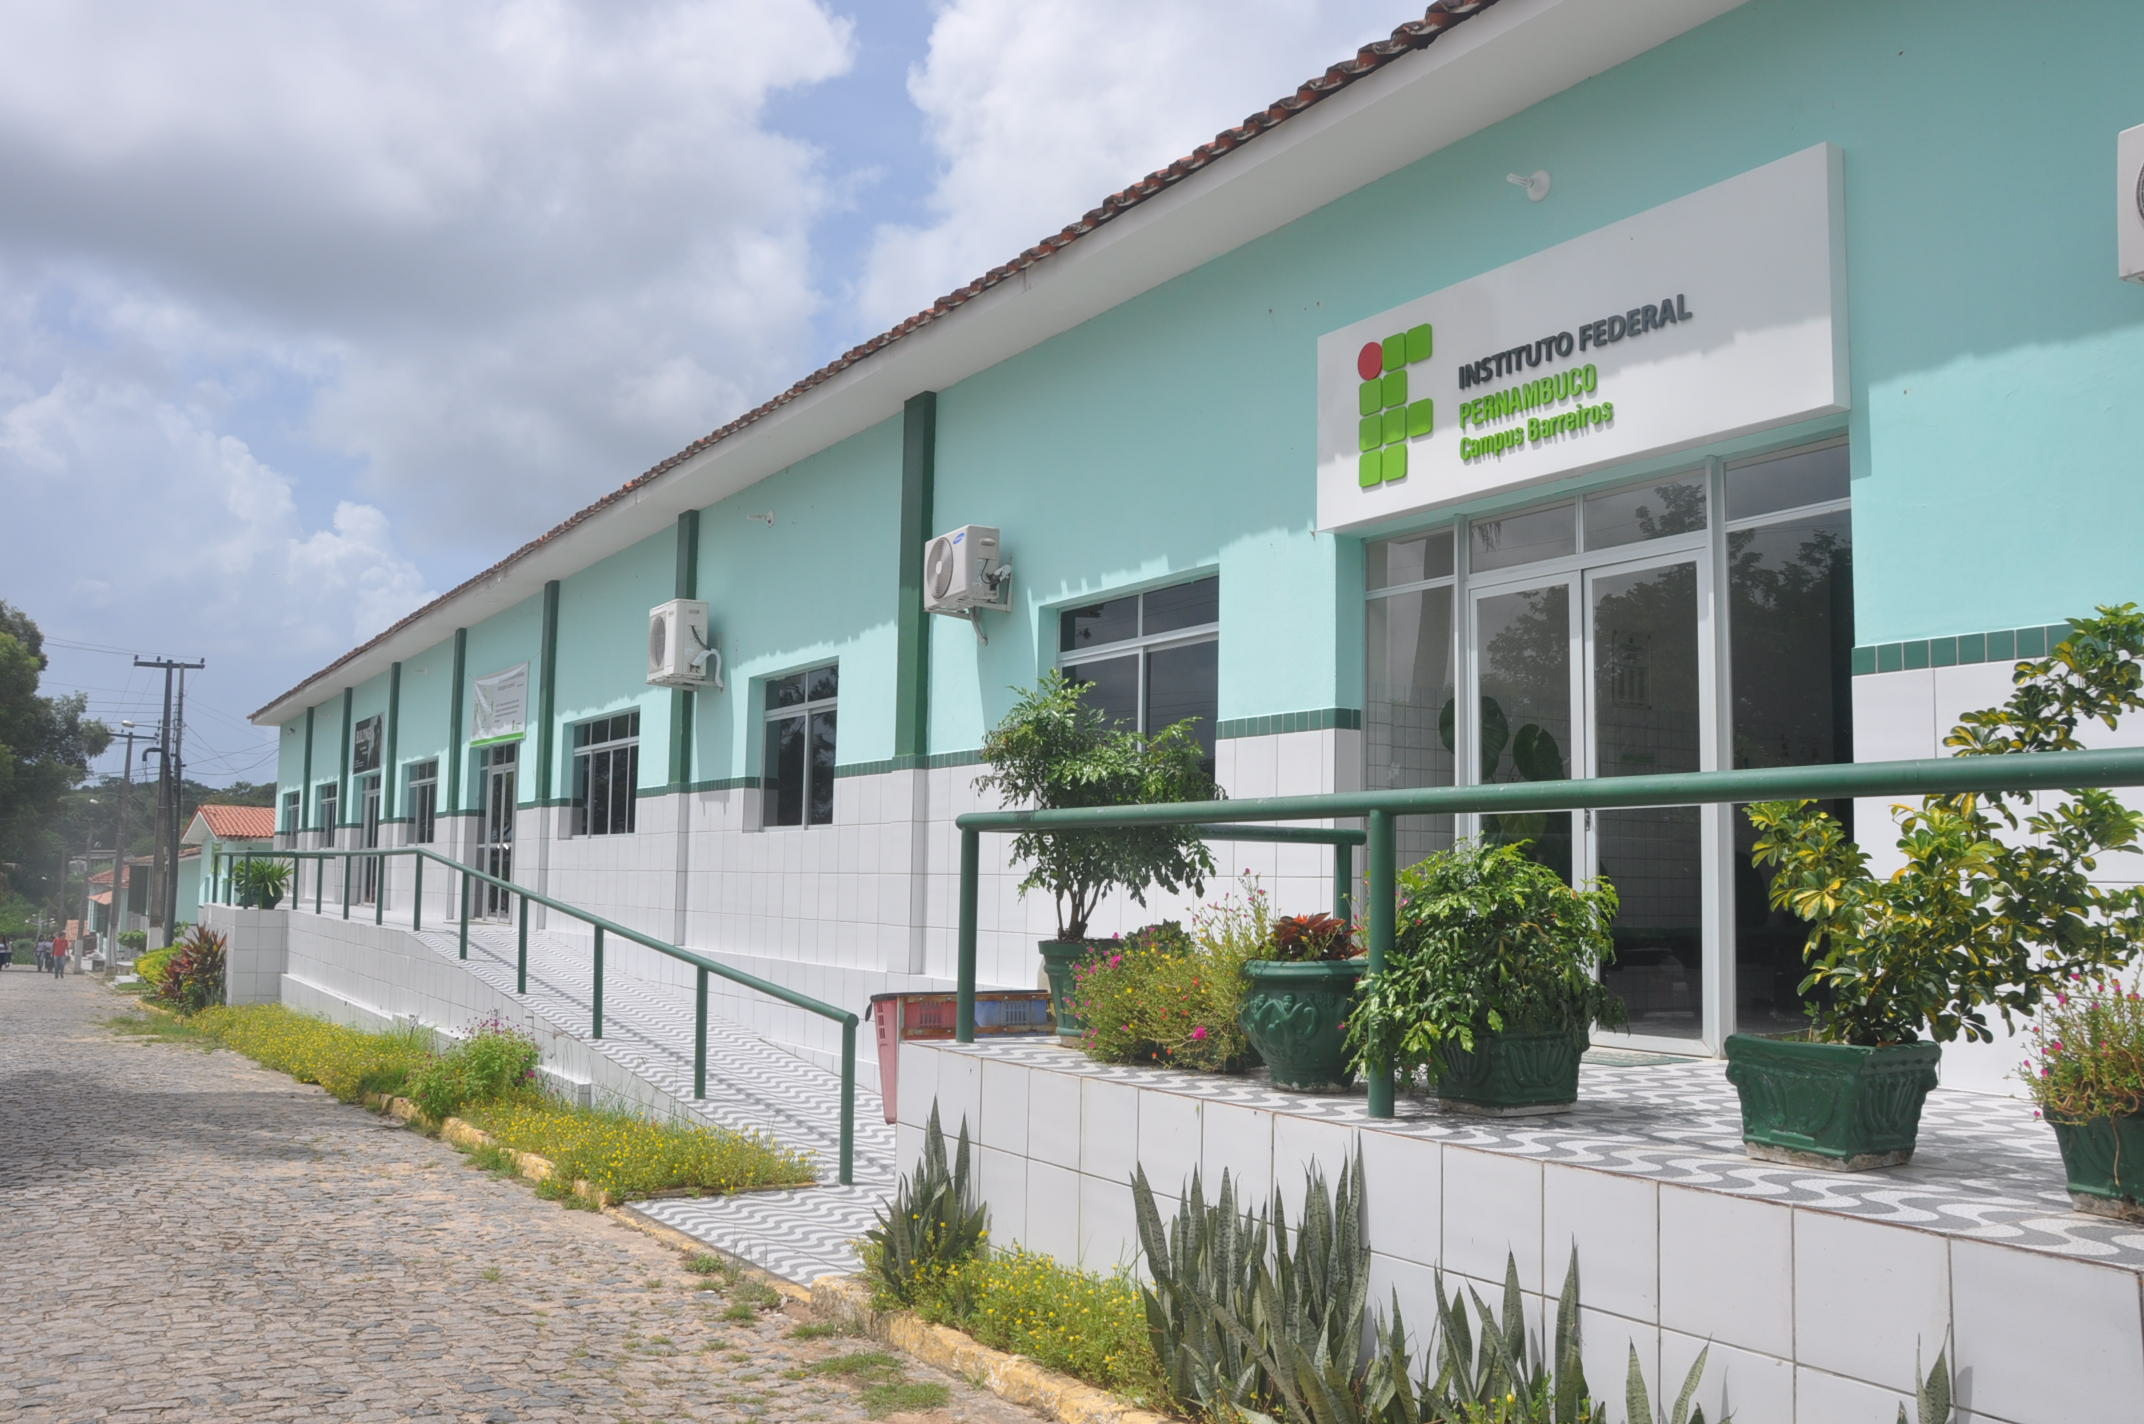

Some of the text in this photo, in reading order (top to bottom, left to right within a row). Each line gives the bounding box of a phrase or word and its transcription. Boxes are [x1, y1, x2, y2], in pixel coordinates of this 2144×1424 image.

[1458, 294, 1692, 389] INSTITUTO FEDERAL
[1459, 363, 1597, 429] PERNAMBUCO
[1460, 402, 1613, 460] Campus Barreiros
